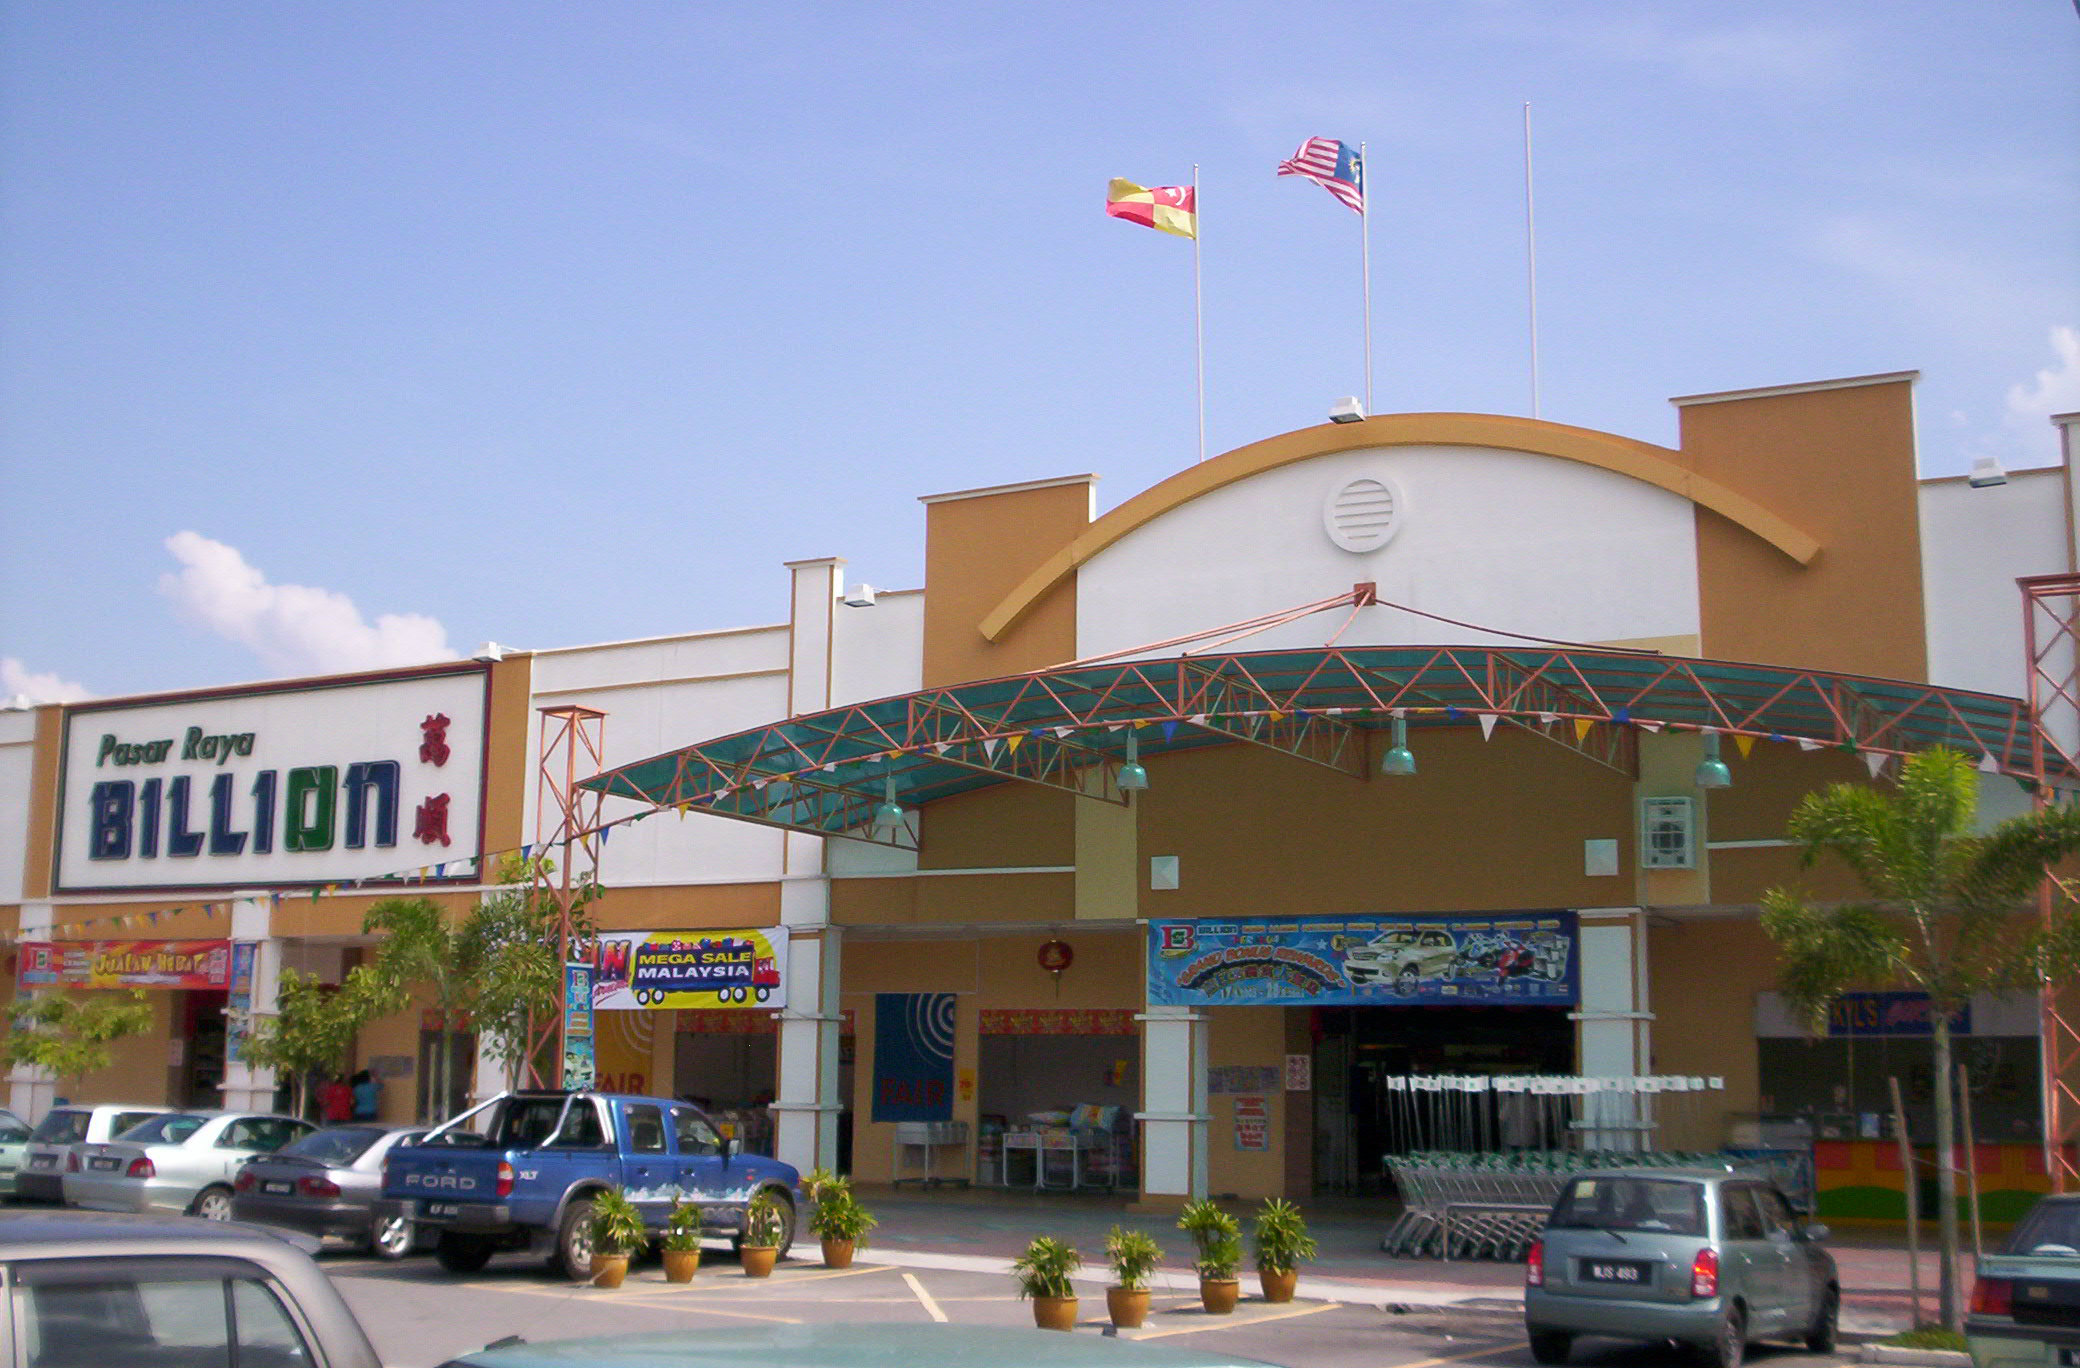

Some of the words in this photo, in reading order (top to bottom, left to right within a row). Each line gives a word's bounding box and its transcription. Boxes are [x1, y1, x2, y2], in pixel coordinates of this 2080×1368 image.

[96, 733, 174, 767] Pasar
[181, 725, 256, 766] Raya
[640, 953, 697, 965] MEGA
[701, 951, 752, 963] SALE
[638, 965, 750, 979] MALAYSIA
[880, 1078, 945, 1107] FAIR
[405, 1174, 476, 1190] FORD
